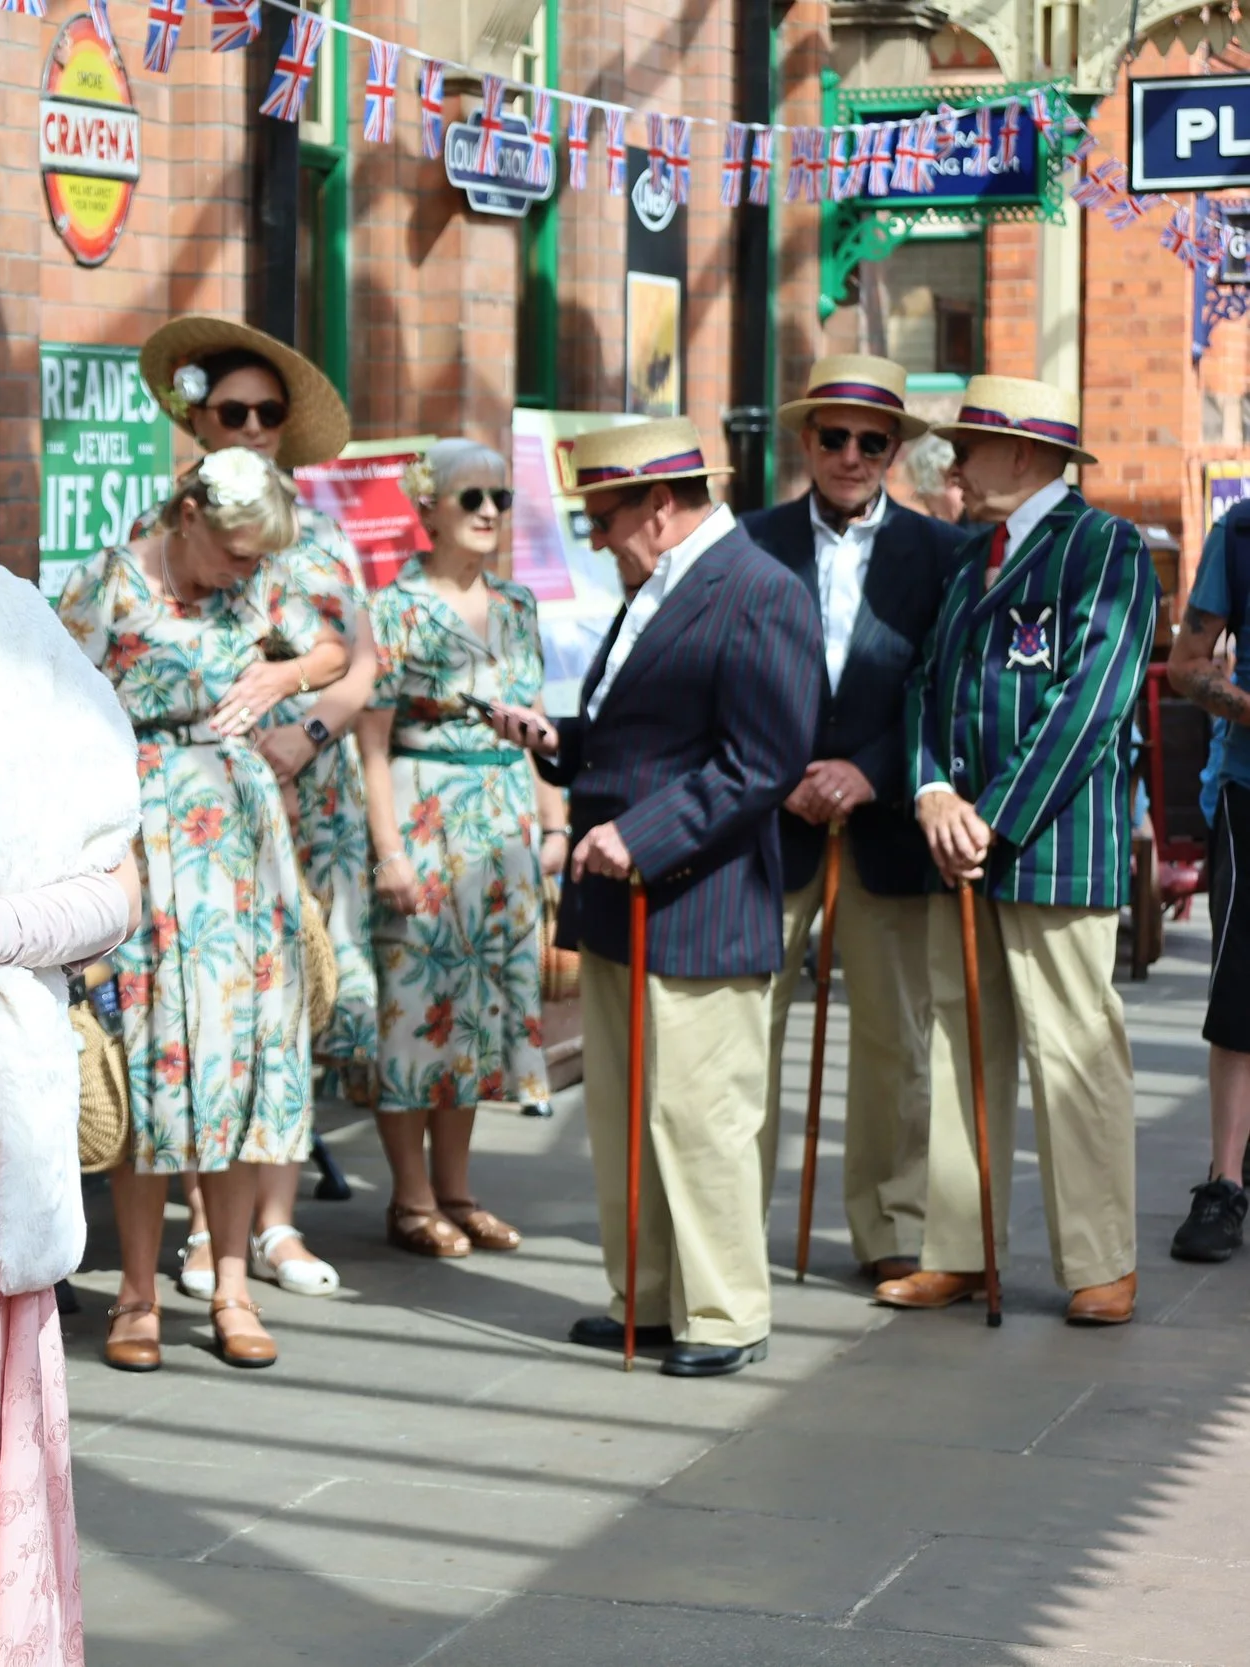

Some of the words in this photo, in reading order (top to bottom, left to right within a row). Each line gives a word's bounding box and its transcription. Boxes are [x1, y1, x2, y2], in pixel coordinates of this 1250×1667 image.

[44, 112, 120, 161] CRAVEN
[1176, 105, 1250, 159] PL
[72, 431, 134, 466] JEWEL
[39, 474, 95, 551] IFE
